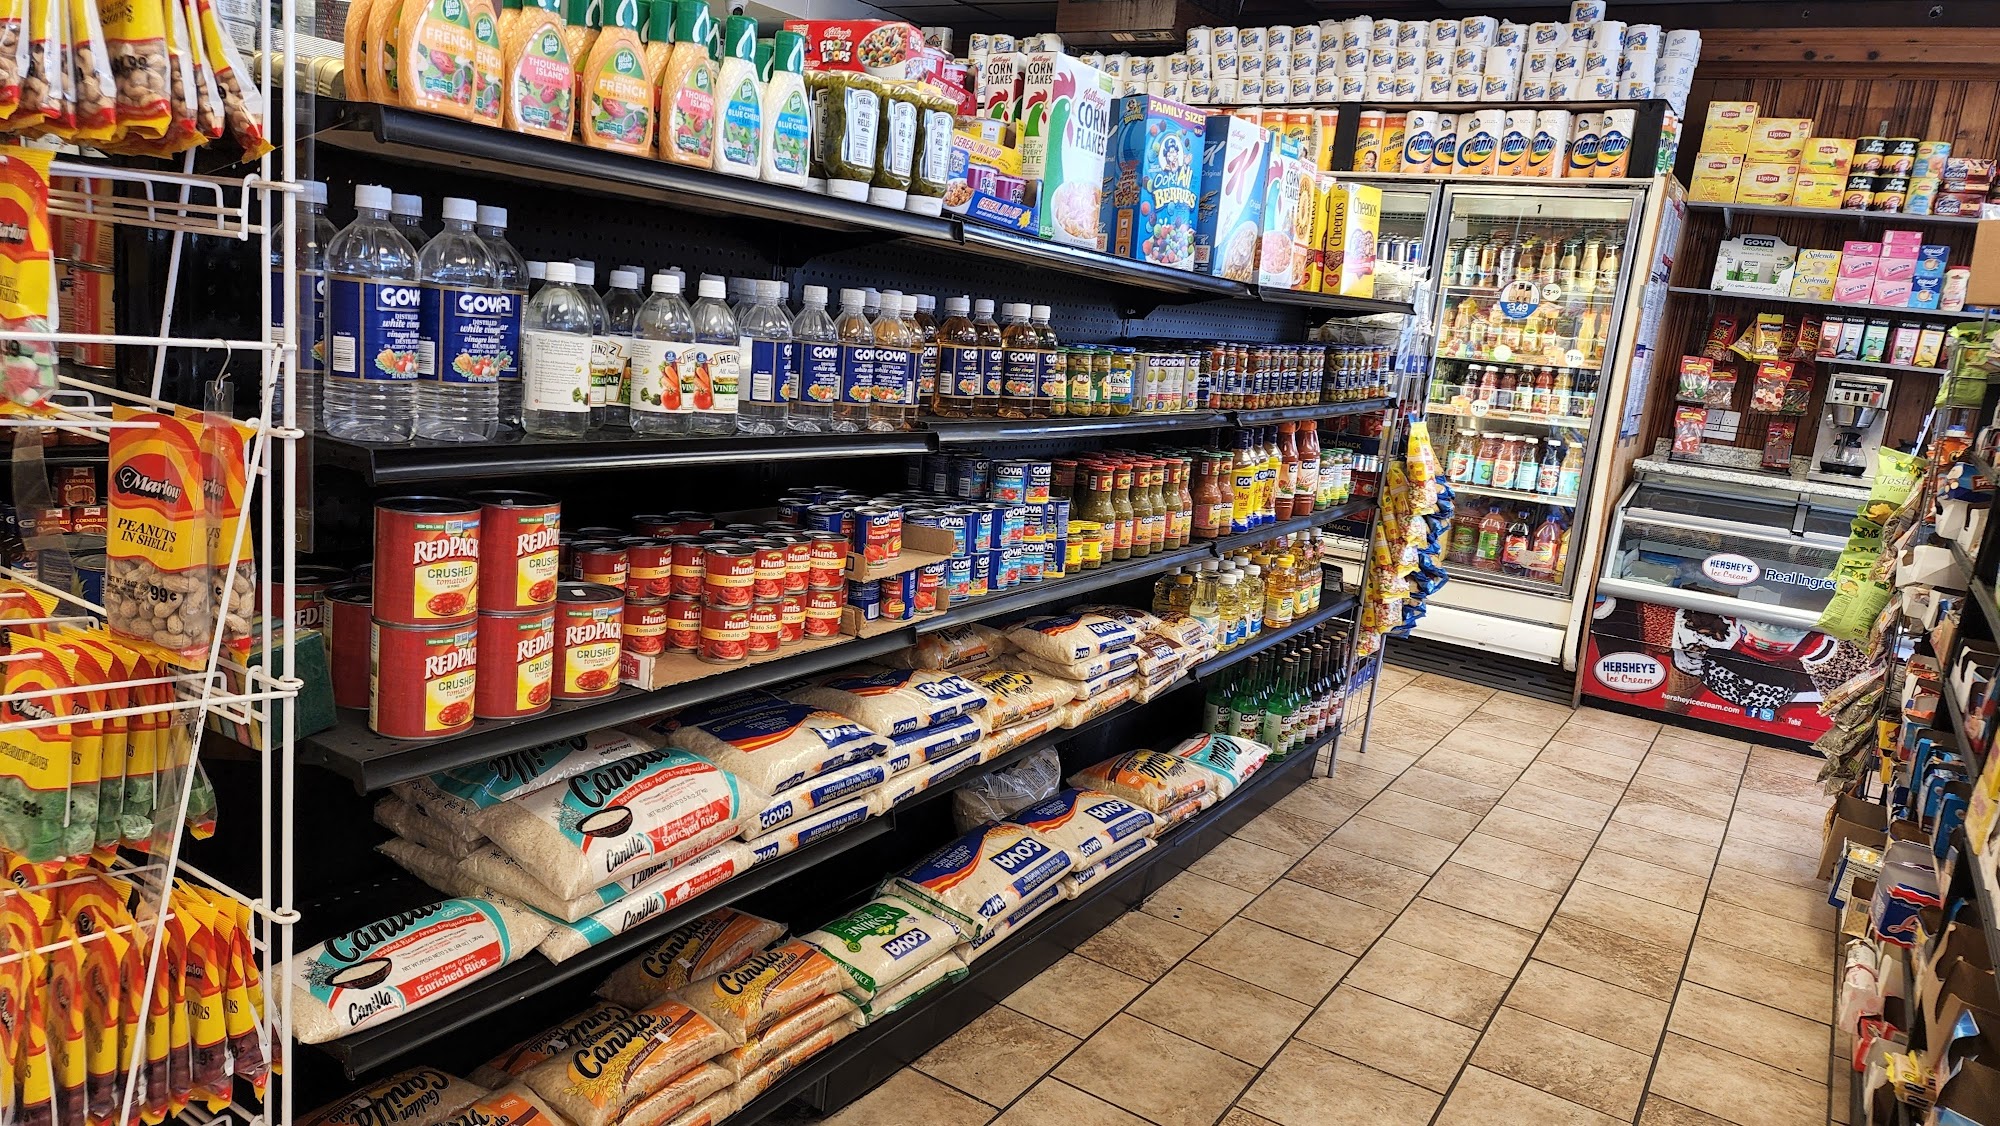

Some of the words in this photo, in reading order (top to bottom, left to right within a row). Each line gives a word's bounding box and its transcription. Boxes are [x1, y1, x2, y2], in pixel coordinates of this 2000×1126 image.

[426, 27, 473, 51] FRENCH
[820, 39, 852, 51] FROOT
[822, 49, 852, 64] LOOPS
[528, 57, 570, 75] THOUSAND
[535, 67, 564, 81] ISLAND
[988, 62, 1013, 75] CORN
[1028, 62, 1053, 75] CORN
[599, 78, 647, 99] FRENCH
[987, 73, 1013, 86] FLAKES
[1027, 73, 1053, 86] FLAKES
[690, 99, 711, 111] ISLAND
[727, 108, 748, 119] BLUE
[1151, 102, 1184, 119] FAMILY
[1185, 110, 1206, 126] SIZE!
[777, 120, 798, 131] BLUE
[1077, 102, 1107, 135] CORN
[954, 136, 976, 149] CEREAL
[1075, 128, 1105, 156] FLAKES
[1769, 131, 1790, 139] Lipton
[1177, 167, 1193, 188] All
[1153, 187, 1197, 210] BERRIES
[1745, 239, 1774, 247] GOYA
[1805, 250, 1836, 260] Splenda
[1800, 275, 1830, 285] Splenda
[458, 294, 512, 313] GOYA
[459, 323, 484, 333] white
[875, 350, 907, 363] GOYA
[1009, 352, 1036, 364] GOYA
[997, 466, 1023, 475] GOYA
[119, 466, 181, 499] Marlow
[117, 518, 177, 544] PEANUTS
[121, 530, 133, 542] IN
[136, 533, 168, 552] SHELL
[516, 528, 560, 556] REDPAC
[1021, 543, 1045, 552] GOYA
[413, 536, 479, 566] REDPACK
[427, 565, 474, 579] CRUSHED
[1710, 558, 1753, 573] HERSHEY'S
[436, 576, 469, 586] tomatoes
[1711, 569, 1723, 578] Ice
[1722, 571, 1749, 581] Cream
[1765, 567, 1796, 584] Real
[150, 585, 177, 603] 99¢
[565, 621, 622, 647] REDPACK
[516, 631, 554, 663] REDPA
[576, 646, 617, 659] CRUSHED
[1603, 661, 1656, 675] HERSHEY'S
[438, 672, 475, 692] CRUSHED
[1606, 672, 1620, 683] Ice
[1620, 673, 1654, 686] Cream
[1661, 692, 1741, 715] hersheyicecream.com
[894, 721, 917, 734] GOYA
[824, 782, 845, 794] MEDIUM
[845, 777, 861, 788] GRAIN
[820, 793, 837, 803] ARROZ
[762, 805, 792, 829] GOYA
[811, 823, 832, 835] MEDIUM
[832, 817, 848, 828] GRAIN
[848, 813, 859, 821] RICE
[661, 821, 700, 847] Enriched
[700, 811, 720, 828] Rice
[606, 837, 646, 873] Canilla
[998, 838, 1043, 870] GOYA
[708, 866, 722, 877] Largo
[690, 869, 732, 897] Enriquecido
[621, 896, 660, 933] Canilla
[884, 930, 927, 956] GOYA
[773, 951, 798, 972] Dorado
[416, 967, 464, 997] Enriched
[465, 956, 488, 974] Rice
[420, 968, 441, 982] Extra
[441, 960, 457, 978] Long
[716, 950, 784, 996] Canilla
[853, 971, 872, 986] RICE
[348, 990, 393, 1027] Canilla
[638, 1014, 673, 1042] Dorado
[572, 1011, 659, 1080] Canilla
